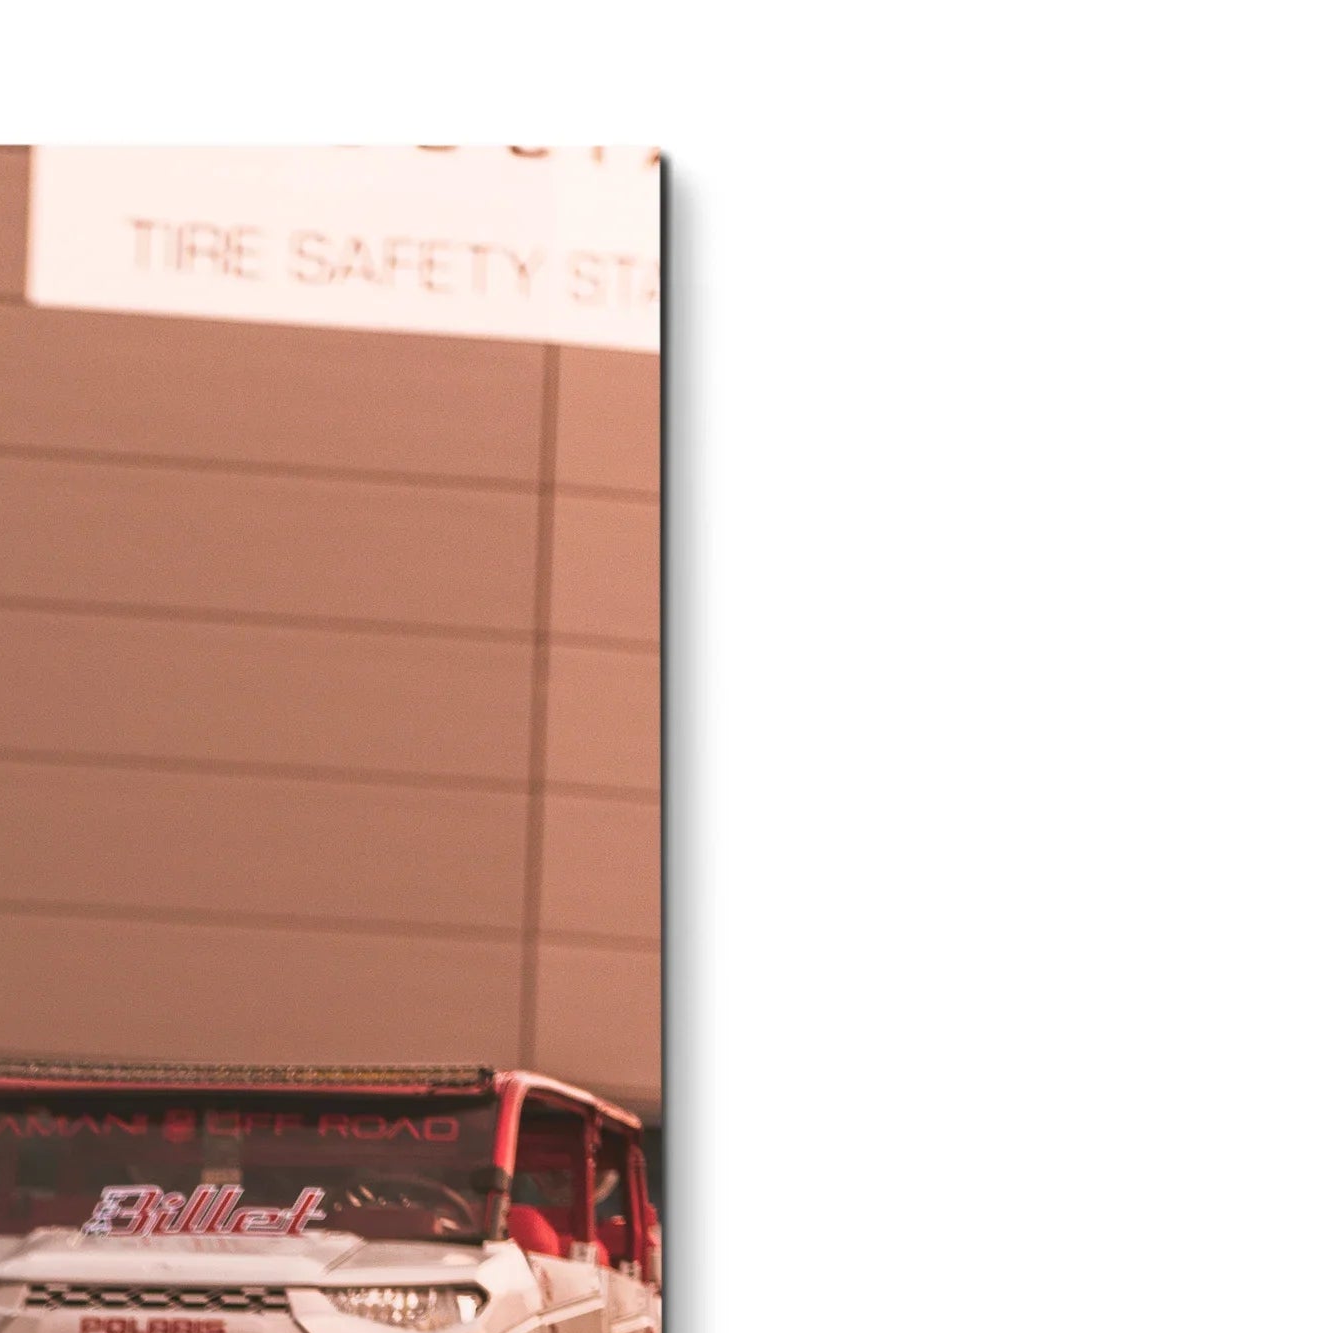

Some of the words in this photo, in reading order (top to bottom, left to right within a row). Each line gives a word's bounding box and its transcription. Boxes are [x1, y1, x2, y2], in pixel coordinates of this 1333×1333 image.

[127, 218, 263, 280] TIRE
[288, 228, 543, 295] SAFETY
[317, 1115, 461, 1142] ROAD
[83, 1184, 326, 1237] Billet
